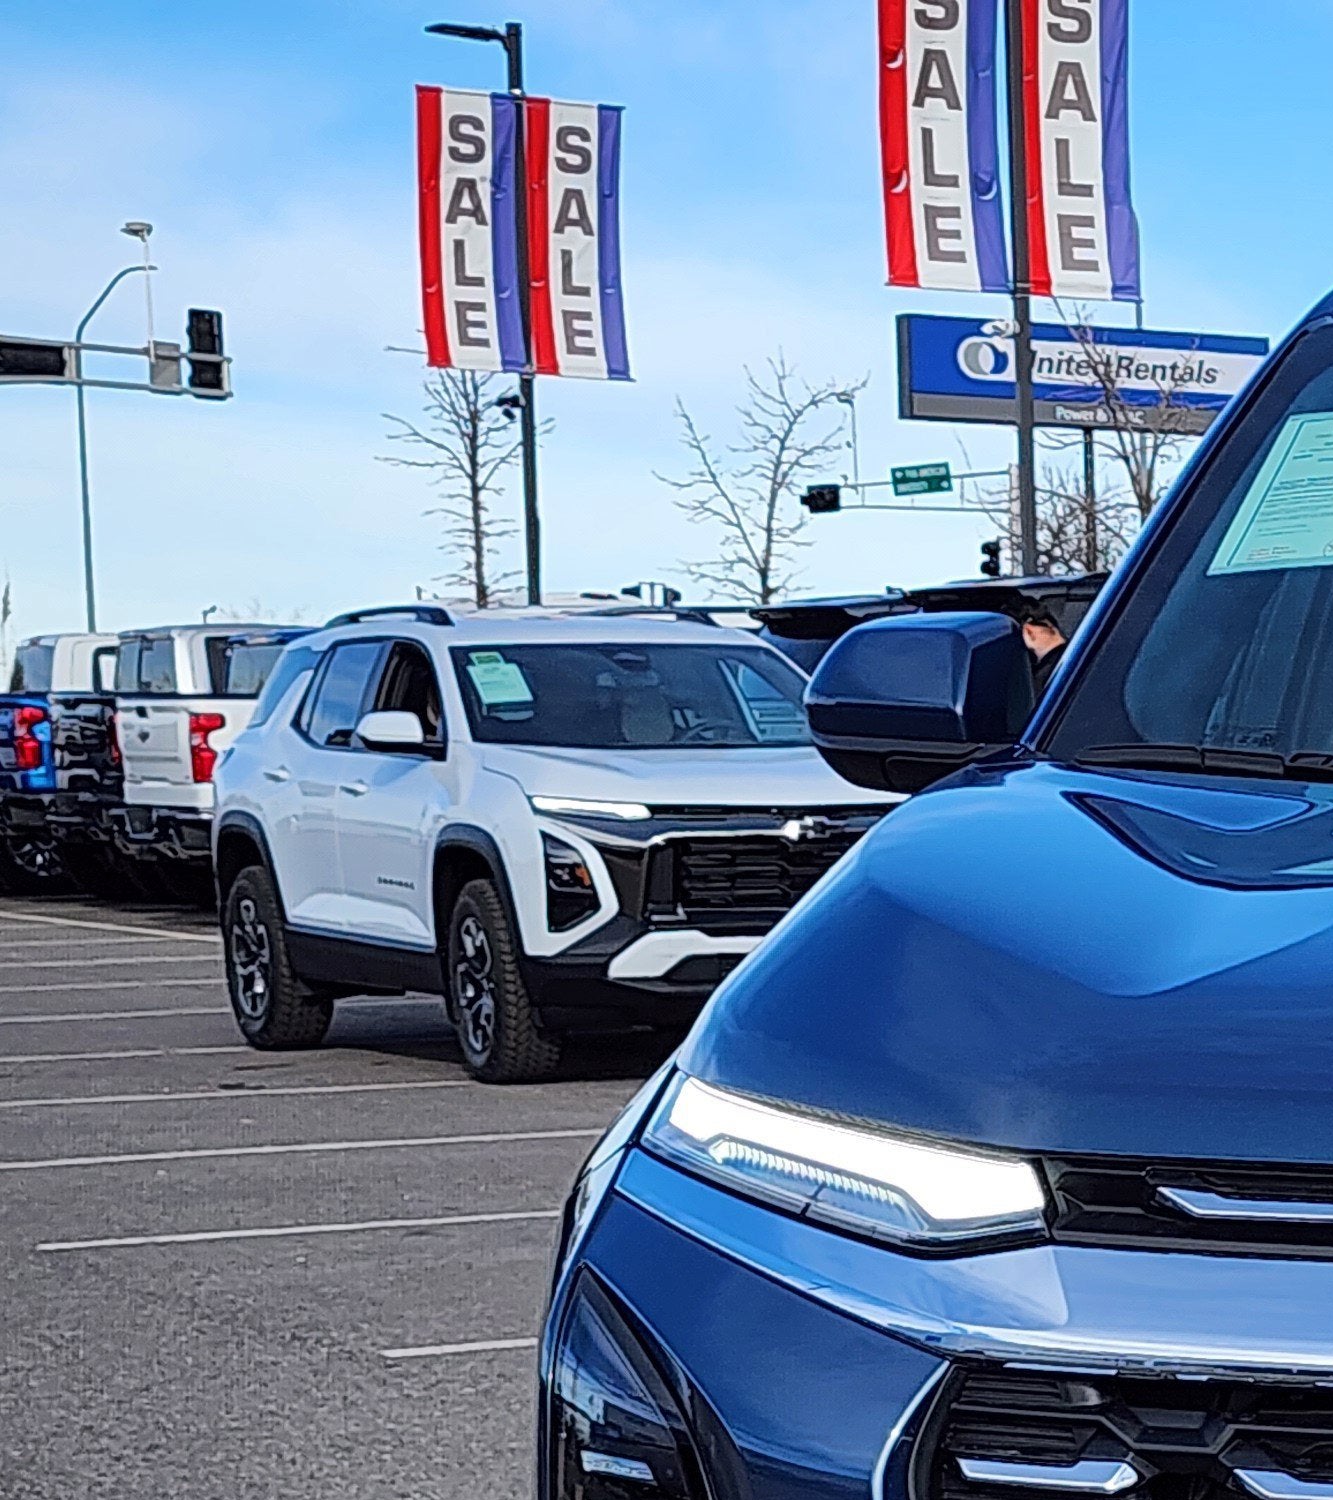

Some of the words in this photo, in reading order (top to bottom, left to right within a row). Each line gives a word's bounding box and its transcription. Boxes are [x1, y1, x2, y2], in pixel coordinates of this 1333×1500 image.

[445, 114, 488, 348] SALE
[553, 125, 597, 357] SALE
[1044, 0, 1100, 272] SALE
[1032, 350, 1112, 379] nited
[1115, 354, 1219, 385] Rentals
